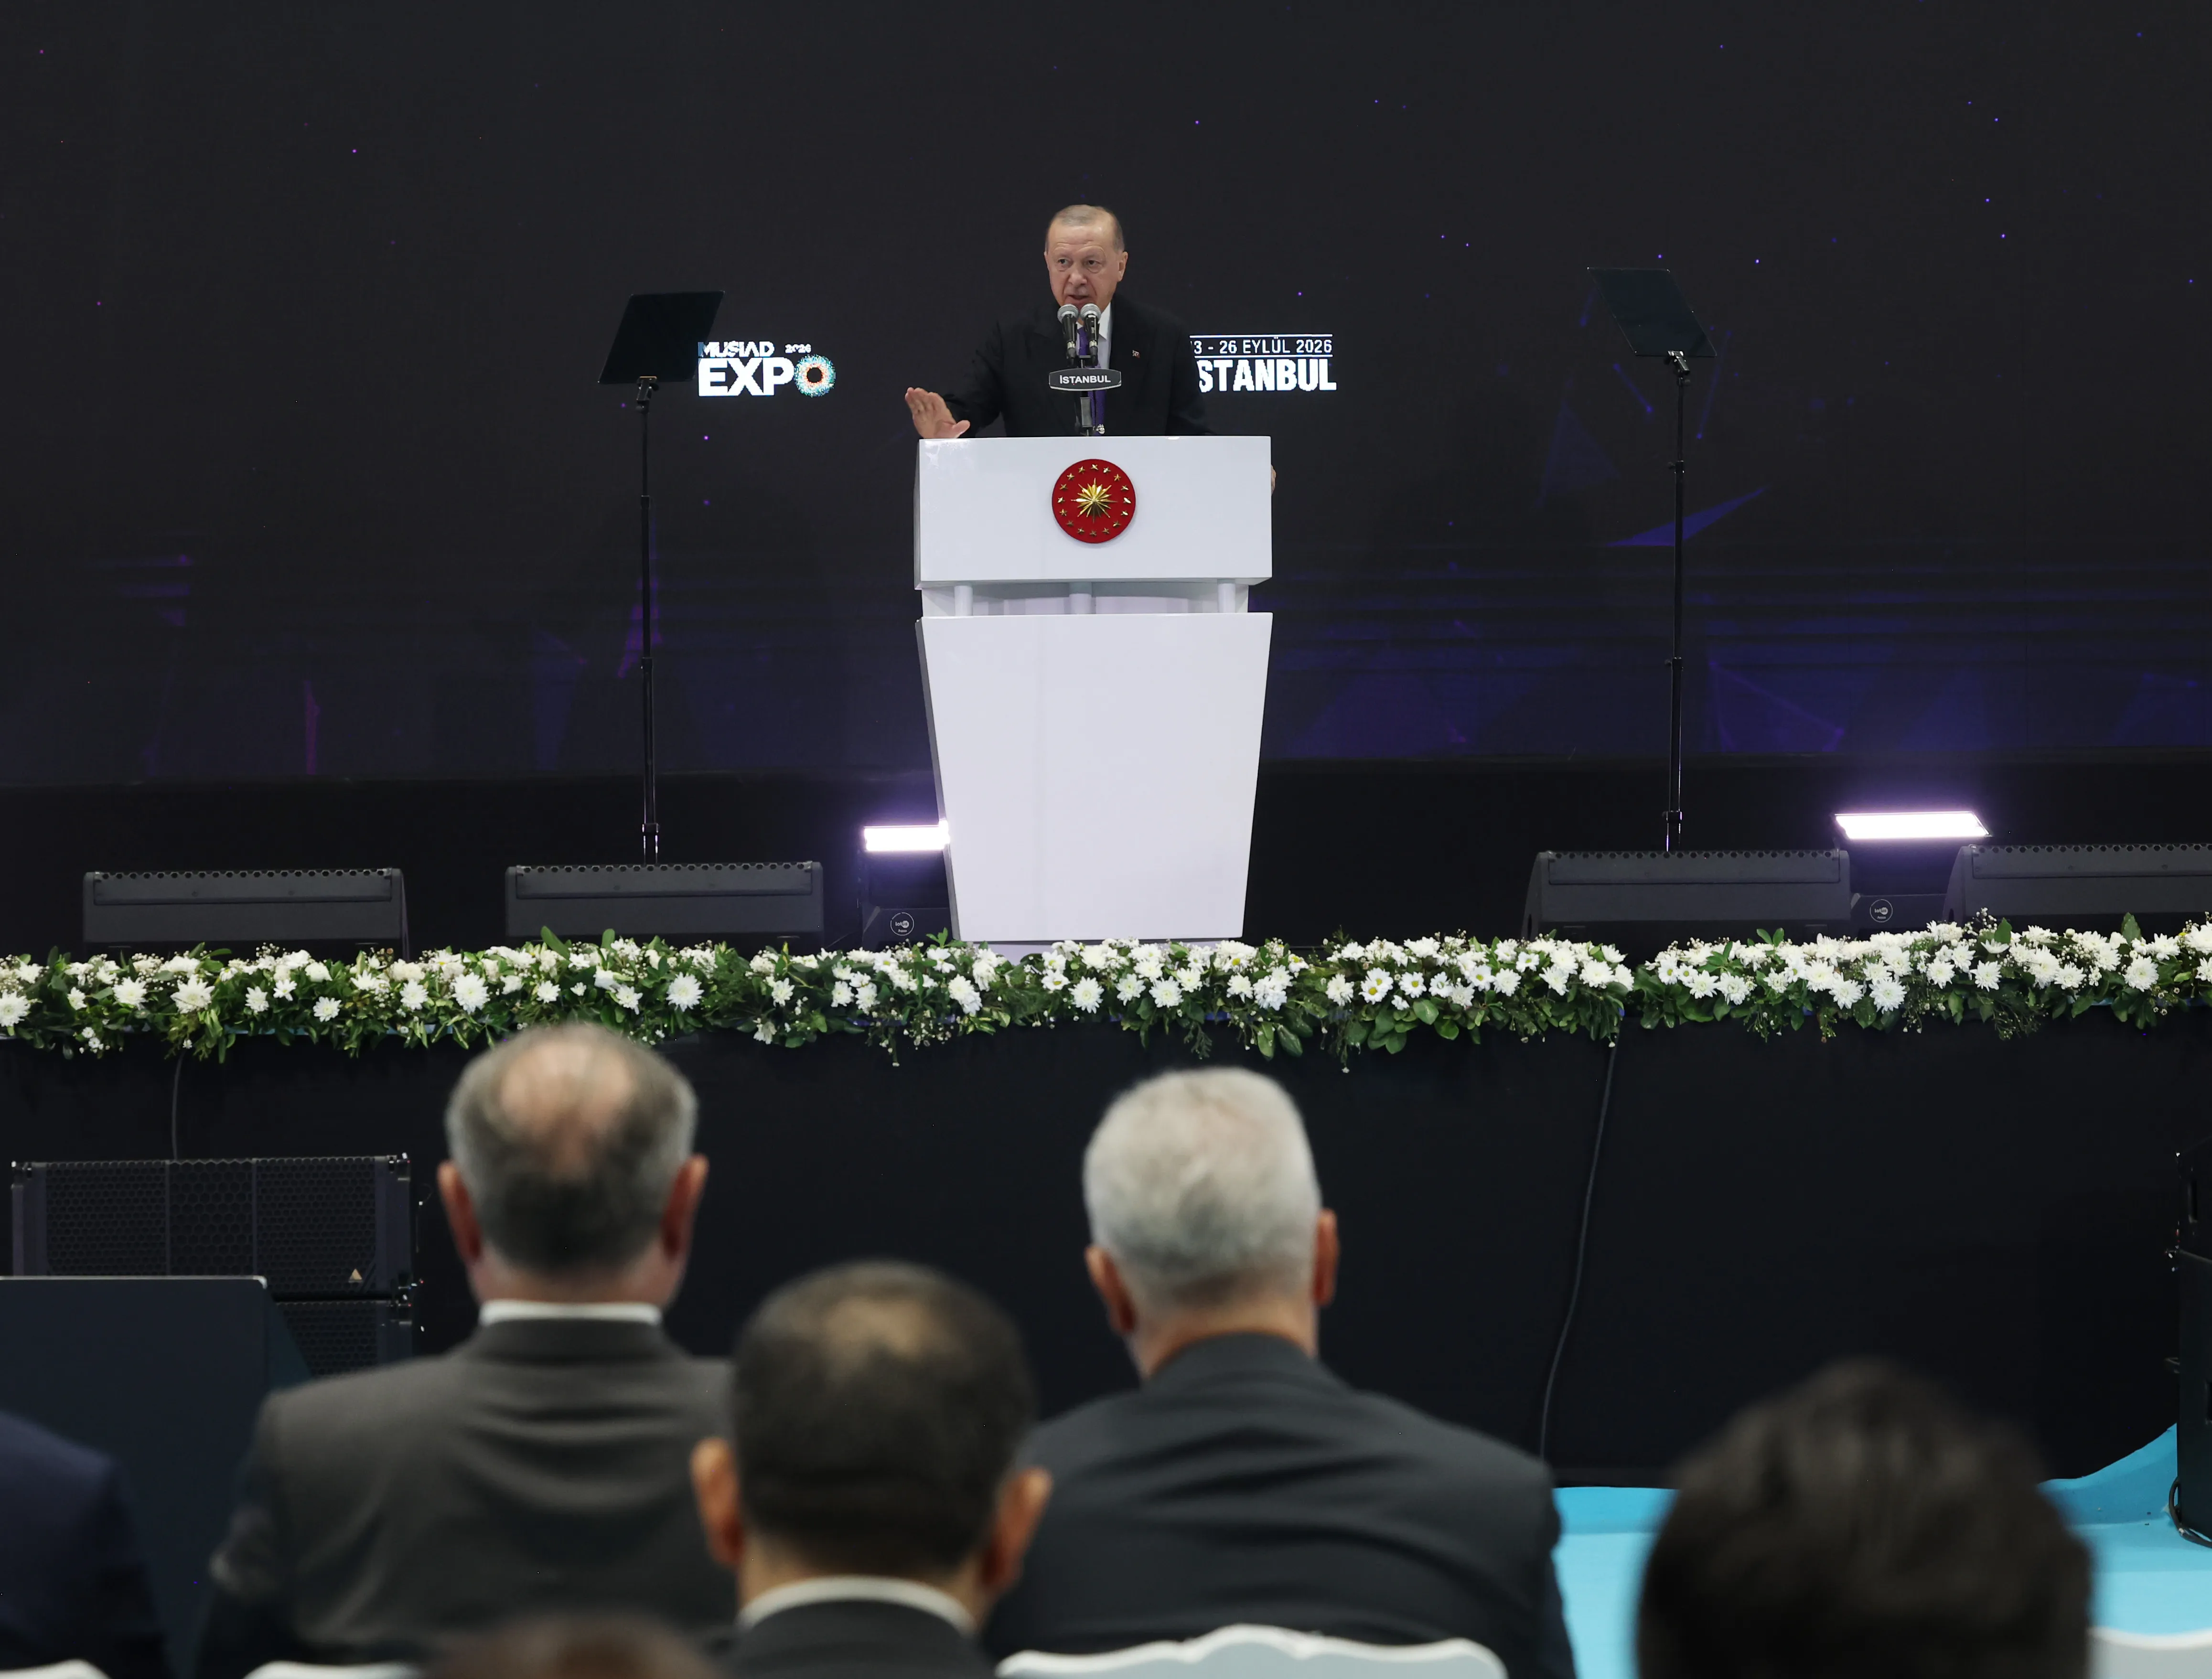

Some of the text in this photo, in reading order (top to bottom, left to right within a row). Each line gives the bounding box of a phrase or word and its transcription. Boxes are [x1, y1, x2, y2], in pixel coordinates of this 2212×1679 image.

[1191, 340, 1202, 354] 3
[1219, 340, 1237, 354] 26
[1243, 337, 1290, 354] EYLÜL
[1296, 339, 1332, 353] 2026
[698, 354, 836, 397] EXPO
[1060, 375, 1111, 384] İSTANBUL
[1197, 359, 1336, 392] STANBUL
